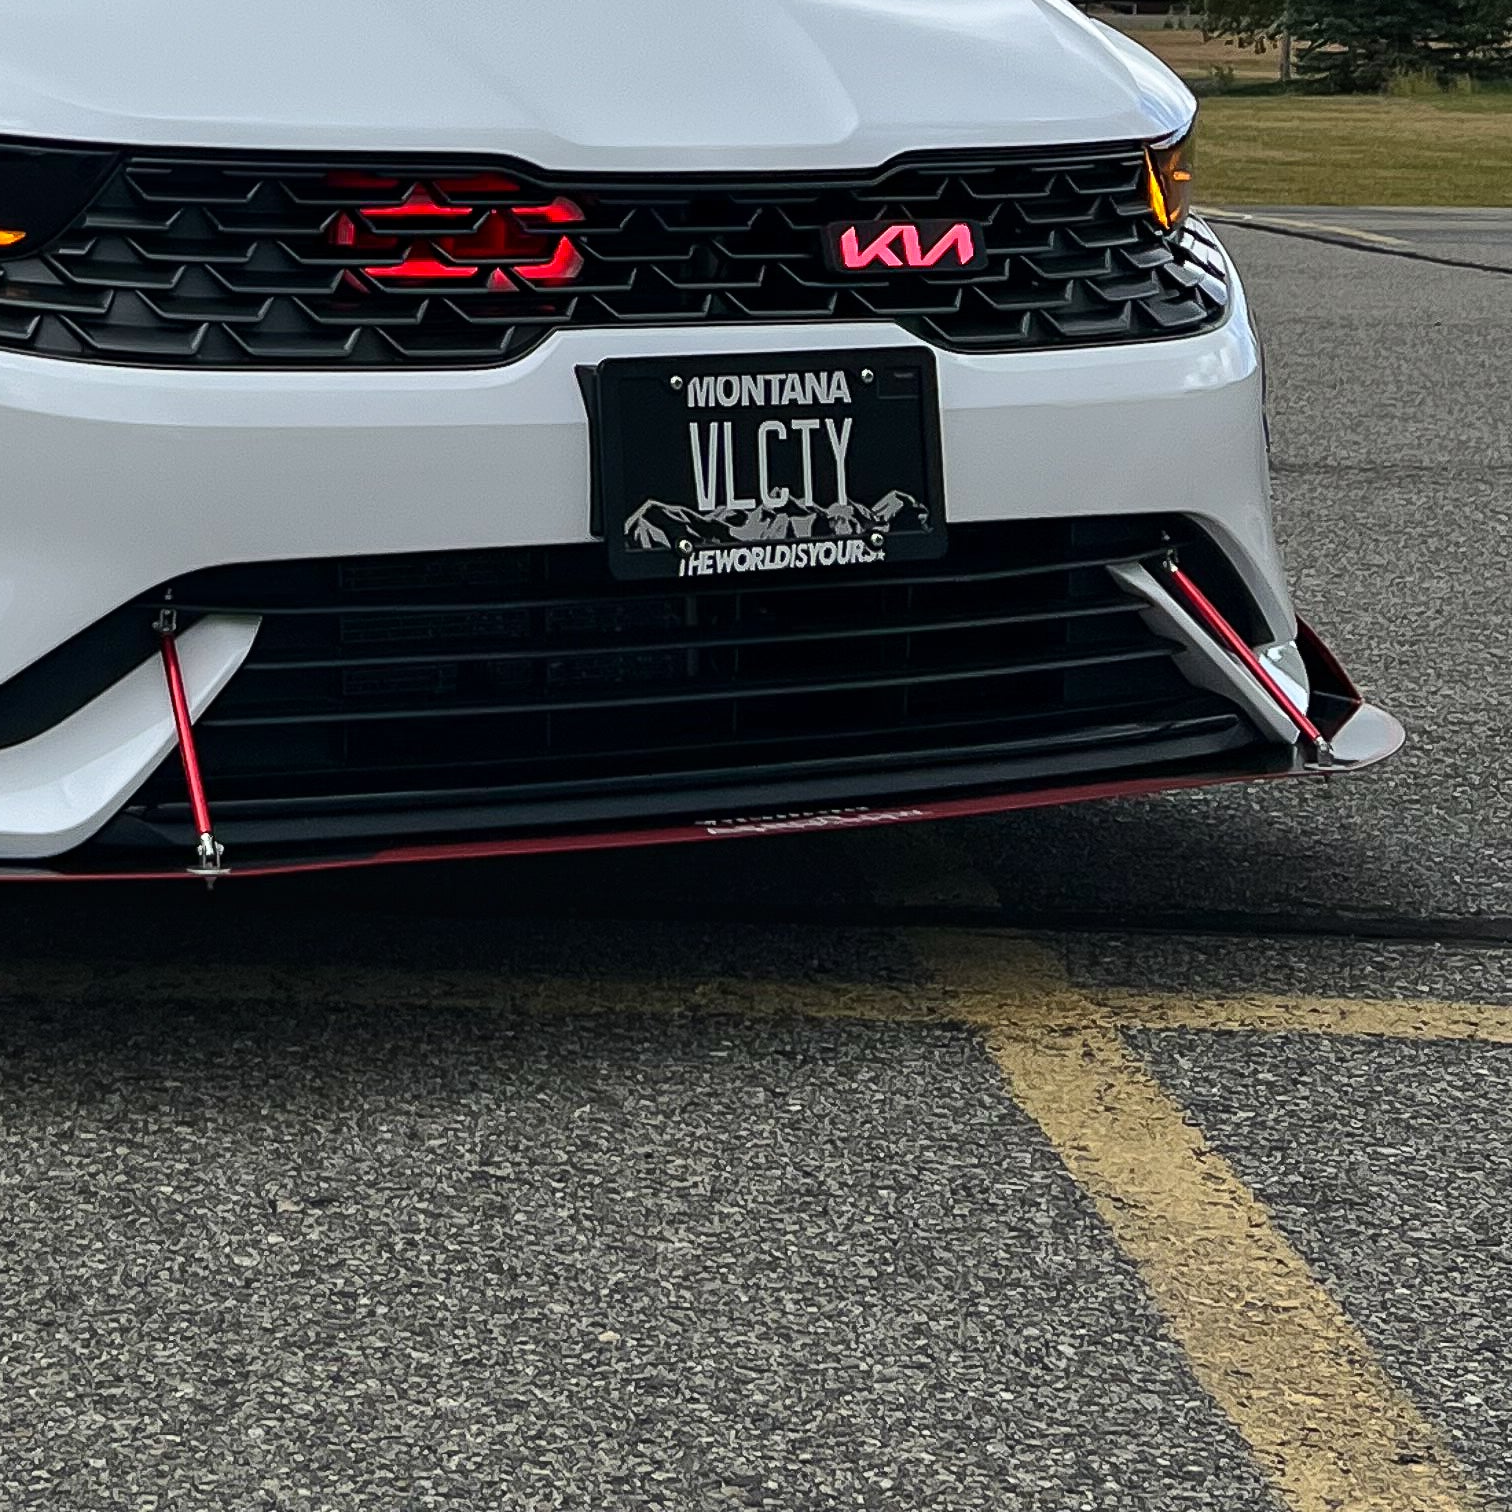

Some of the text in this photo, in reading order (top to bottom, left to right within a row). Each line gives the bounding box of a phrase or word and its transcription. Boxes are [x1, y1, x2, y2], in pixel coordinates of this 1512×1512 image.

[841, 223, 974, 268] KIA
[688, 370, 851, 407] MONTANA
[689, 417, 852, 511] VLCTY
